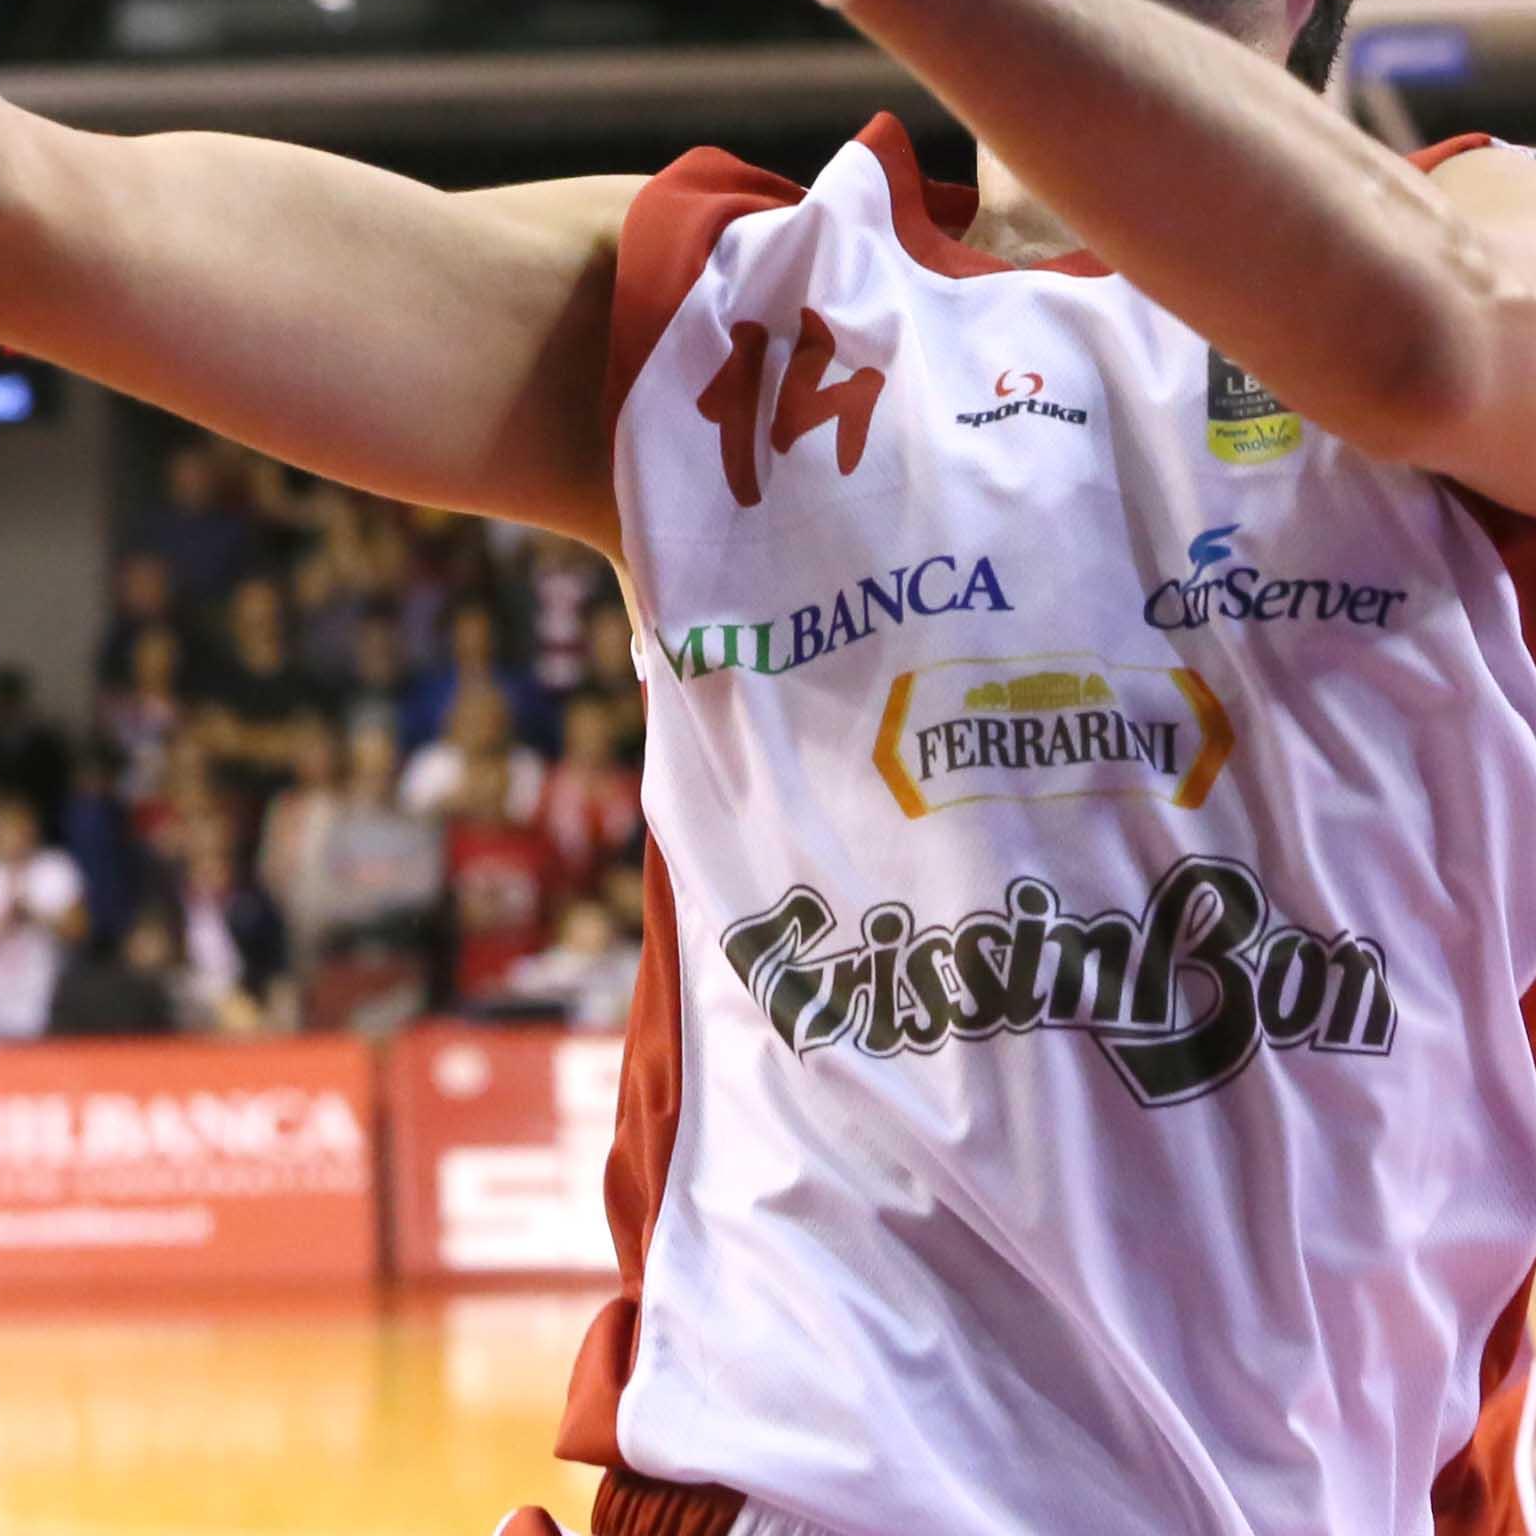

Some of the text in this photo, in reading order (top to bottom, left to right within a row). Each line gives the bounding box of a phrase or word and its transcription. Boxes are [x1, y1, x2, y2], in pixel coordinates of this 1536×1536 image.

[697, 307, 884, 508] 14
[955, 397, 1088, 428] sportika
[915, 706, 1180, 781] FERRARINI
